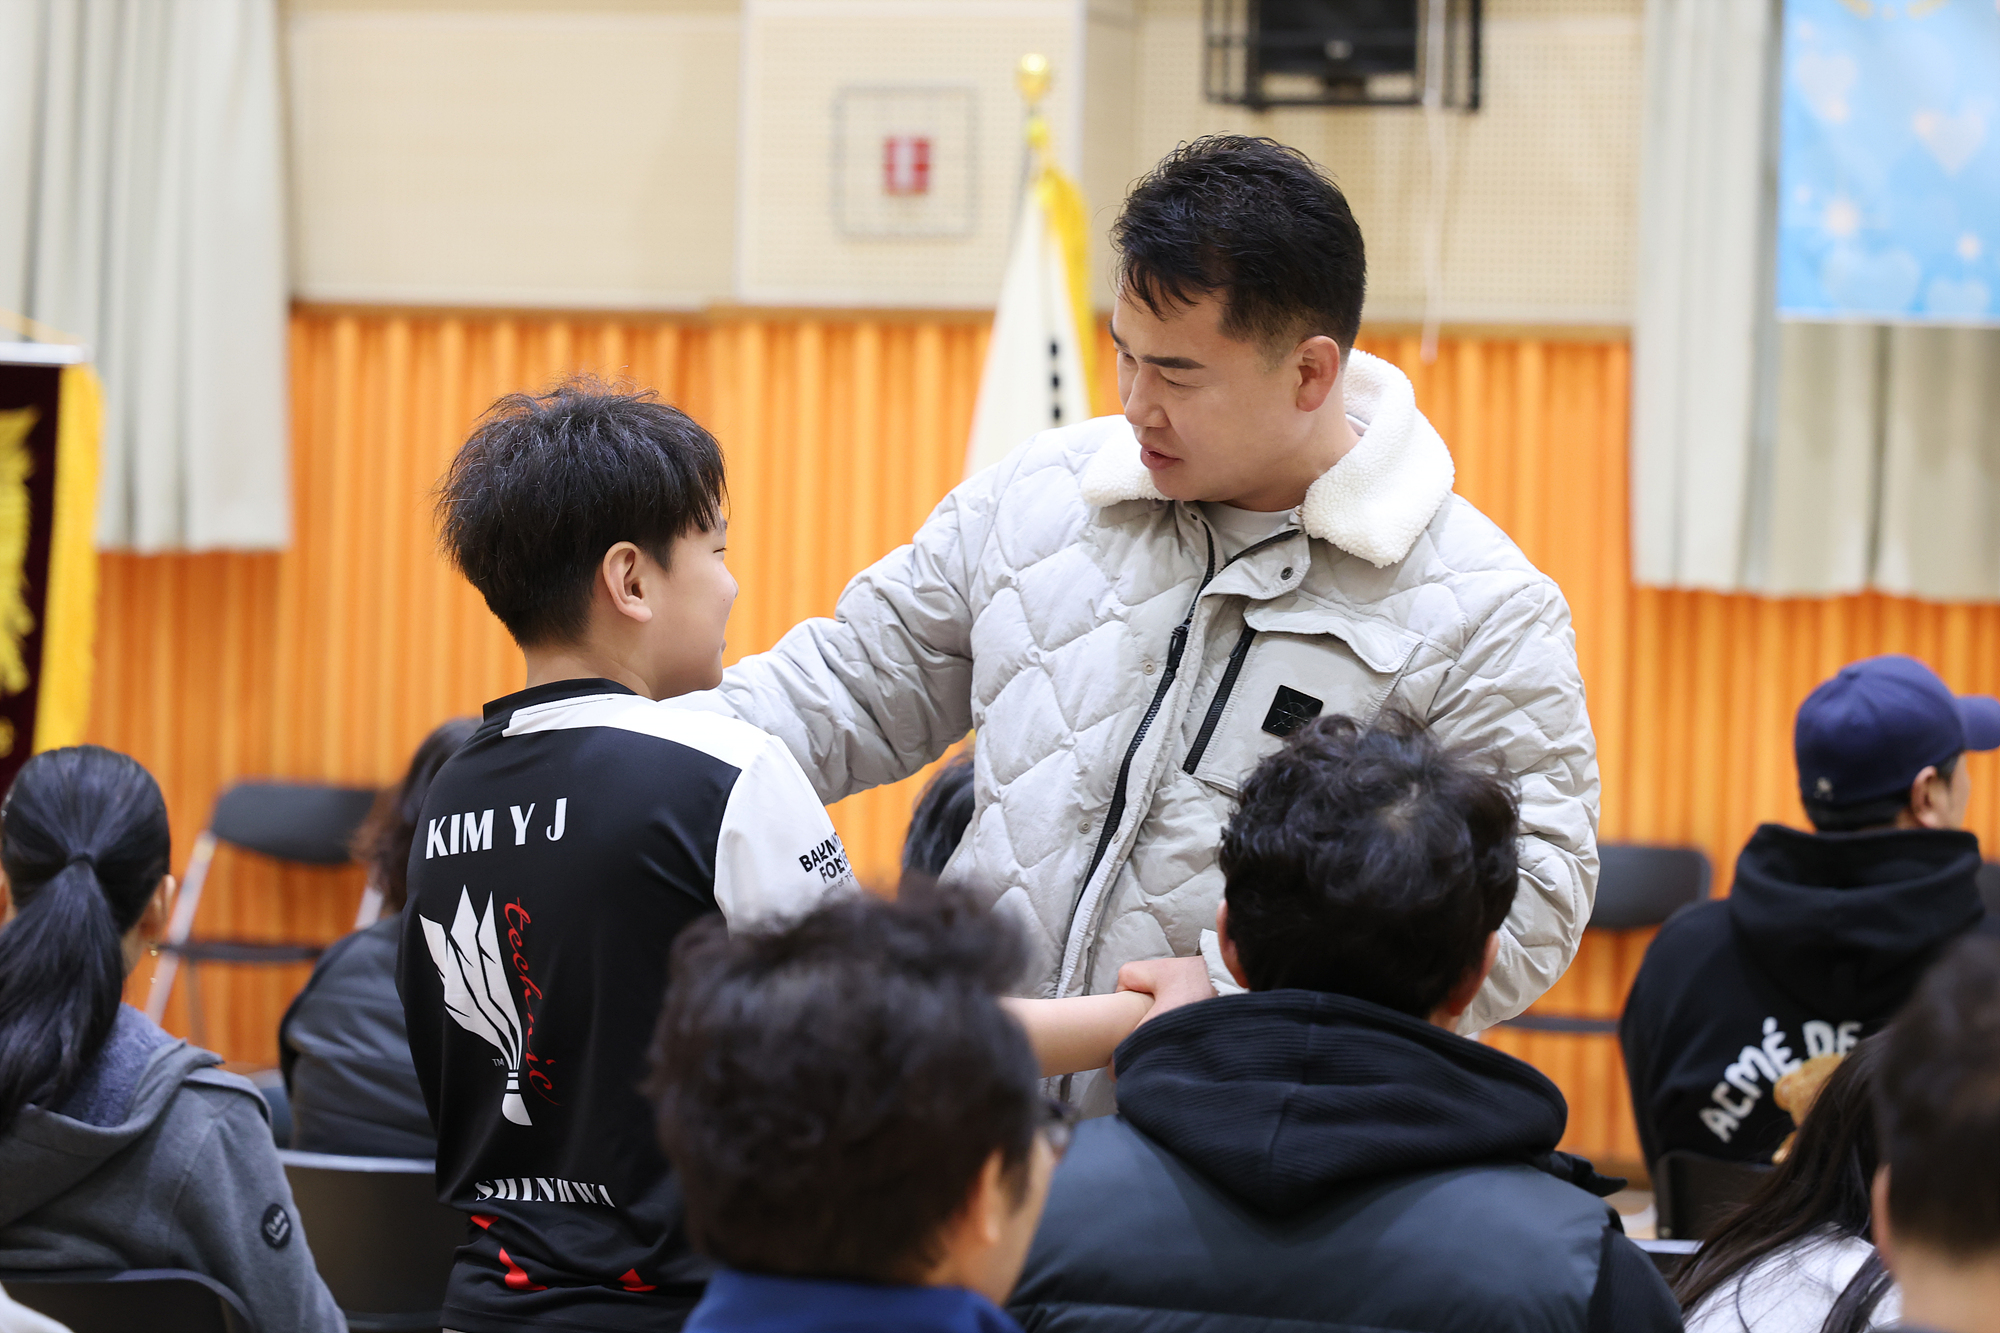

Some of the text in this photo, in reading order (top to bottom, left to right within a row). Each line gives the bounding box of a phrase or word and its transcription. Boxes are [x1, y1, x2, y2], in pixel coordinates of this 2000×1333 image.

[426, 797, 567, 860] KIM Y J
[504, 896, 564, 1106] technic
[1699, 1016, 1803, 1144] ACMÉ
